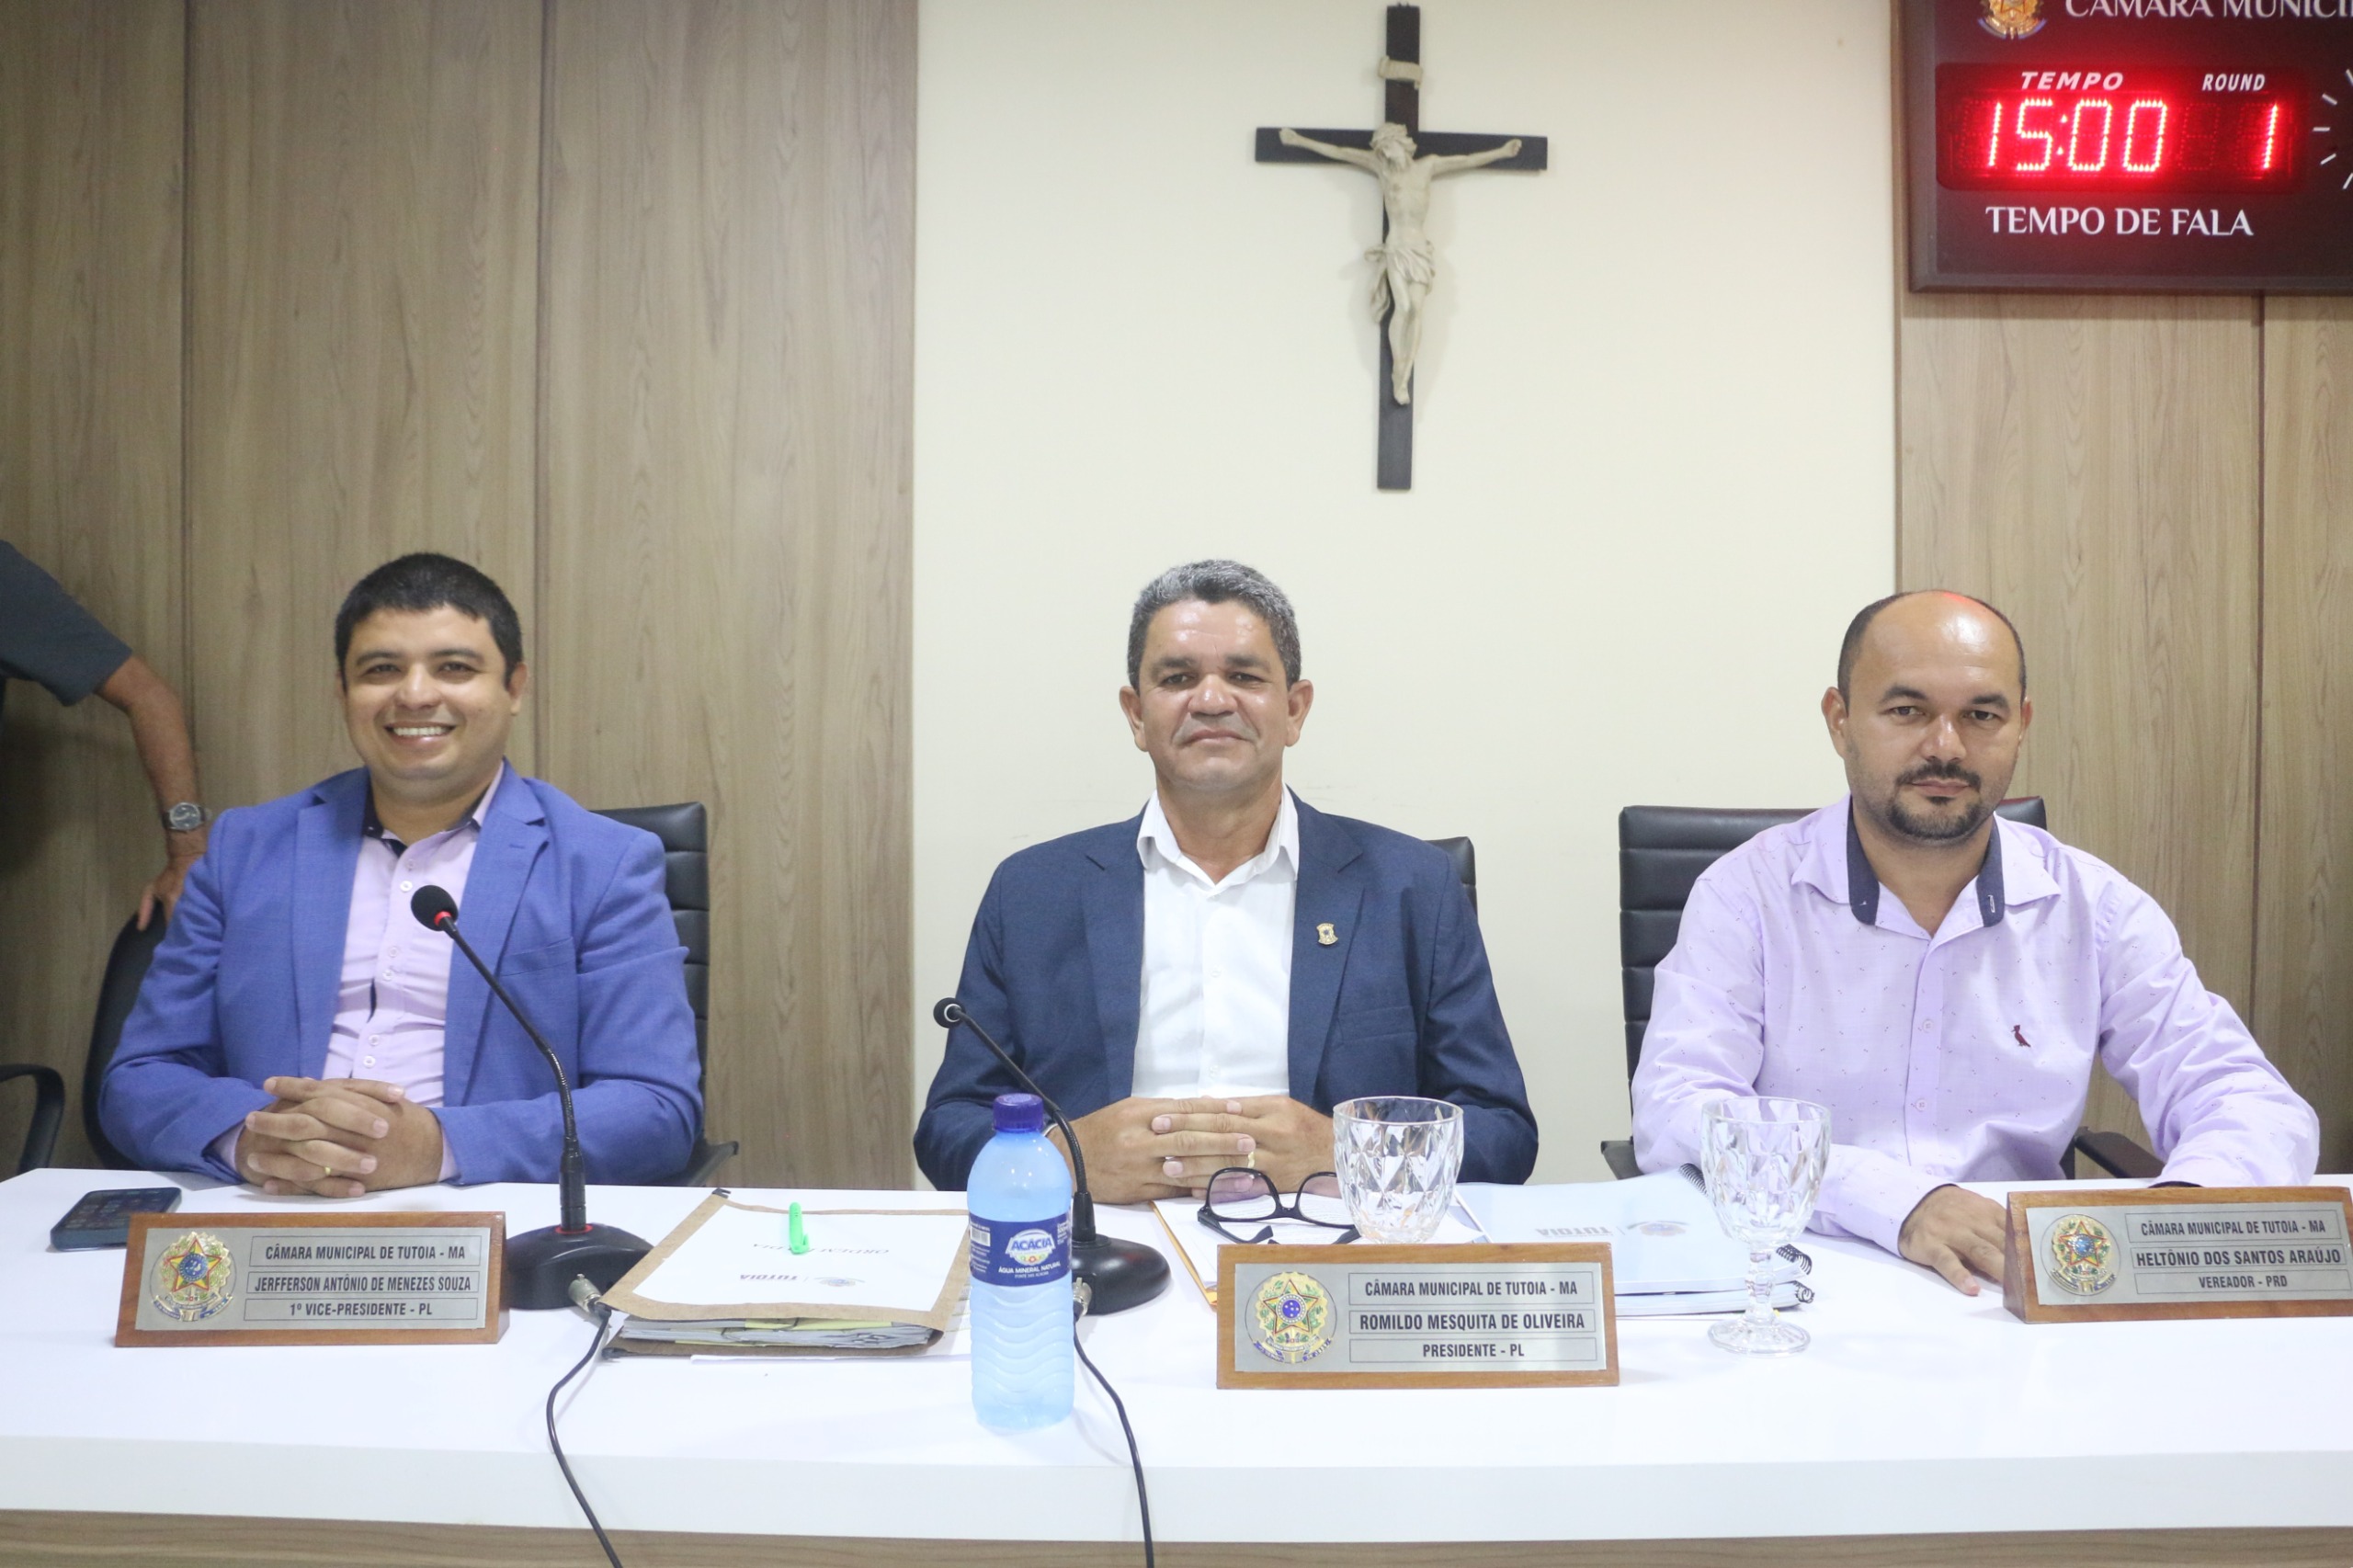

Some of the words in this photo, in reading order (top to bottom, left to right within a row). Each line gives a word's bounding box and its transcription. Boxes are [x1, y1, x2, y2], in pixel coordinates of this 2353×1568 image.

[2223, 0, 2353, 18] MUNICI
[2020, 71, 2124, 90] TEMPO
[2201, 74, 2266, 92] ROUND
[1987, 97, 2168, 172] 15:00
[2263, 103, 2279, 170] 1
[1985, 207, 2106, 235] TEMPO
[2116, 208, 2161, 235] DE
[2170, 209, 2255, 235] FALA
[2141, 1221, 2186, 1236] CÂMARA
[2188, 1221, 2244, 1235] MUNICIPAL
[2246, 1221, 2260, 1234] DE
[2262, 1220, 2299, 1233] TUTOIA
[2309, 1220, 2326, 1233] MA
[266, 1243, 313, 1260] CÂMARA
[316, 1245, 376, 1260] MUNICIPAL
[380, 1245, 393, 1259] DE
[398, 1245, 436, 1259] TUTOIA
[448, 1245, 465, 1259] MA
[2136, 1249, 2200, 1267] HELTÔNIO
[2205, 1251, 2231, 1266] DOS
[2234, 1250, 2285, 1265] SANTOS
[2290, 1246, 2341, 1264] ARAÚJO
[255, 1277, 320, 1292] JERFFERSON
[323, 1273, 368, 1291] ANTÔNIO
[371, 1277, 384, 1291] DE
[387, 1276, 435, 1291] MENEZES
[438, 1276, 471, 1291] SOUZA
[1365, 1279, 1415, 1296] CÂMARA
[1418, 1281, 1483, 1296] MUNICIPAL
[1487, 1281, 1502, 1296] DE
[1506, 1281, 1547, 1296] TUTOIA
[1559, 1280, 1577, 1295] MA
[2199, 1276, 2255, 1289] VEREADOR
[2266, 1275, 2288, 1288] PRD
[305, 1302, 406, 1316] VICE-PRESIDENTE
[419, 1302, 433, 1315] PL
[1359, 1314, 1423, 1330] ROMILDO
[1427, 1313, 1497, 1332] MESQUITA
[1501, 1313, 1518, 1329] DE
[1523, 1312, 1585, 1329] OLIVEIRA
[1423, 1344, 1496, 1358] PRESIDENTE
[1509, 1343, 1525, 1357] PL
